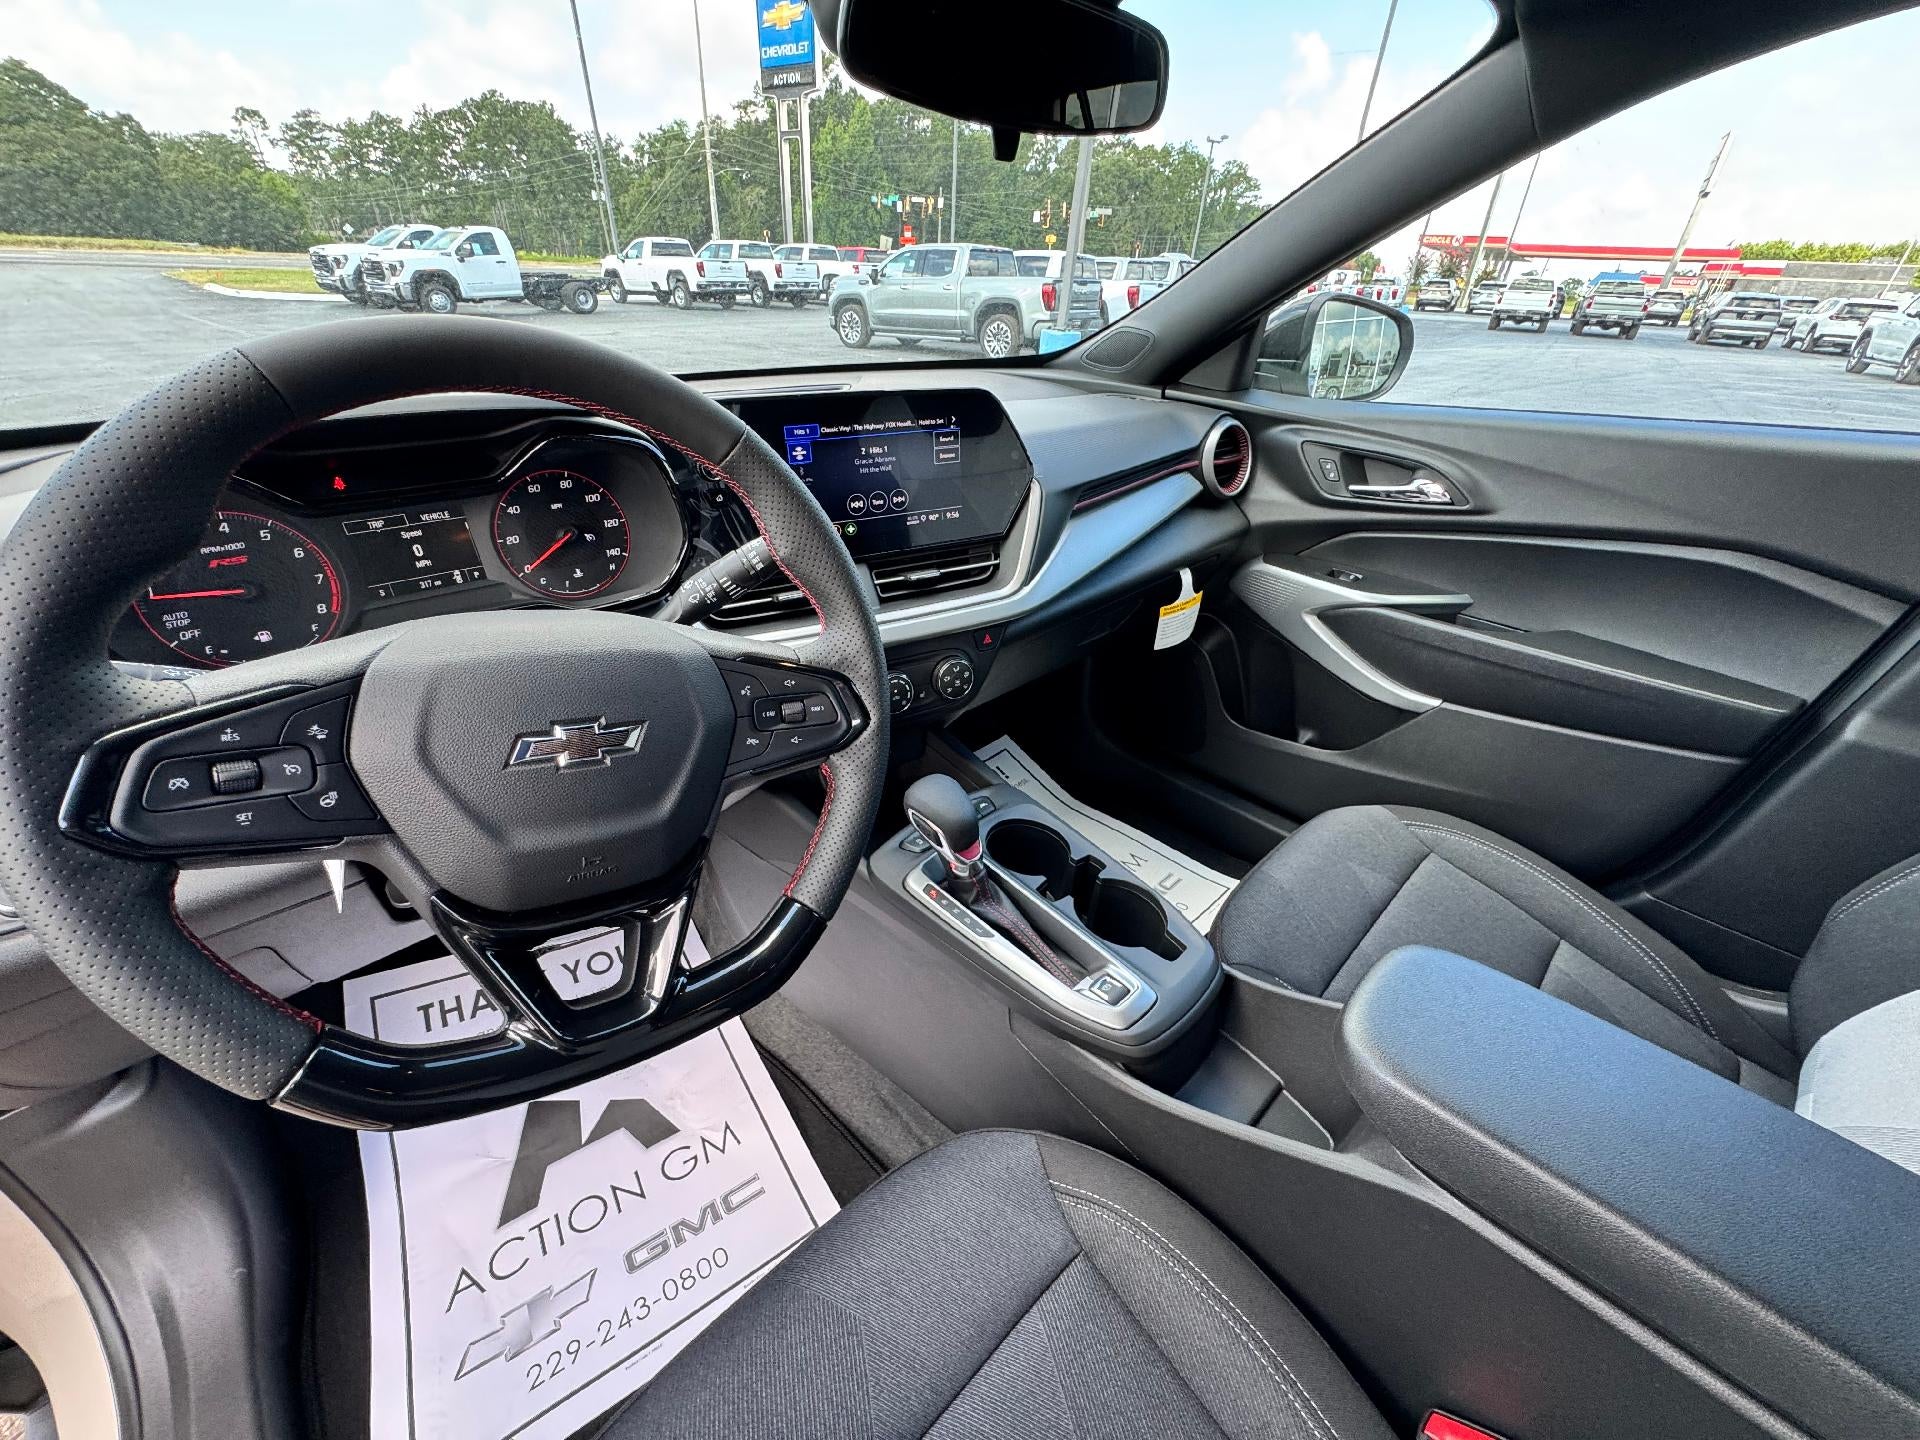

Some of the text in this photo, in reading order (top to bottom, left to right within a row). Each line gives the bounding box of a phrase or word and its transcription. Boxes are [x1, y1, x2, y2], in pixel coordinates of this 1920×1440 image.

[761, 41, 809, 59] CHEVROLET
[773, 71, 801, 86] ACTION
[1422, 236, 1451, 244] CIRCLE
[863, 423, 884, 431] Highway
[861, 447, 866, 455] 2
[869, 446, 883, 454] Hits
[854, 455, 896, 465] Gracie Abrams
[879, 464, 892, 472] Wall
[528, 484, 541, 494] 60
[560, 480, 572, 489] 80
[584, 493, 601, 503] 100
[506, 505, 521, 515] 40
[946, 511, 960, 519] 9:56
[419, 510, 451, 521] VEHICLE
[218, 522, 230, 534] 4
[367, 520, 385, 530] TRIP
[603, 518, 619, 528] 120
[259, 530, 271, 541] 5
[400, 529, 423, 540] Speed
[506, 535, 520, 545] 20
[293, 547, 305, 558] 6
[412, 543, 424, 557] 0
[605, 547, 621, 558] 140
[415, 559, 433, 569] MPH
[524, 564, 532, 574] 0
[609, 563, 616, 571] H
[314, 573, 324, 585] 7
[419, 579, 433, 589] 317
[540, 577, 547, 585] C
[379, 589, 386, 597] S
[316, 603, 327, 614] 8
[162, 611, 188, 622] AUTO
[165, 618, 191, 629] STOP
[311, 623, 319, 632] F
[179, 628, 201, 641] OFF
[205, 645, 214, 655] E
[220, 732, 241, 742] RES
[235, 812, 252, 822] SET
[416, 989, 499, 1033] THA
[445, 1119, 742, 1314] ACTION GM
[623, 1173, 766, 1275] GMC
[525, 1246, 730, 1392] 229-243-0800
